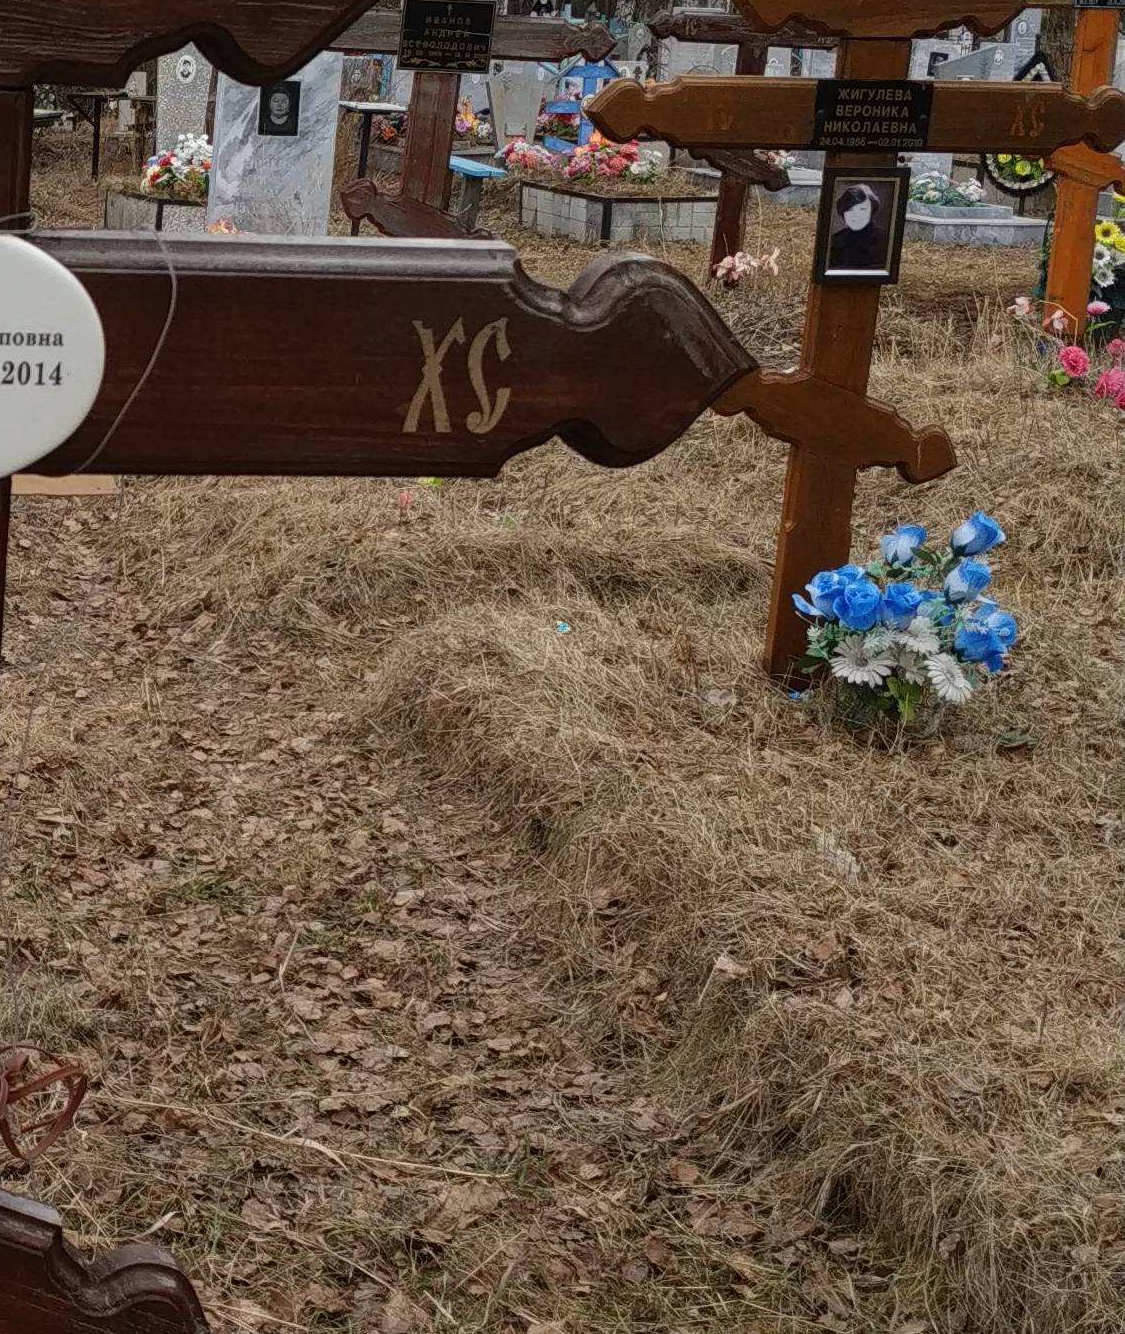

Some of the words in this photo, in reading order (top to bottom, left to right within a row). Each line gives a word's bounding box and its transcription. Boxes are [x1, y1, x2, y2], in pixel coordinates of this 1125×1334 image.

[425, 16, 472, 26] ИВАНОВ
[837, 88, 913, 101] ЖИГУЛЕВА
[835, 105, 909, 118] ВЕРОНИКА
[823, 120, 917, 134] НИКОЛАЕВНА
